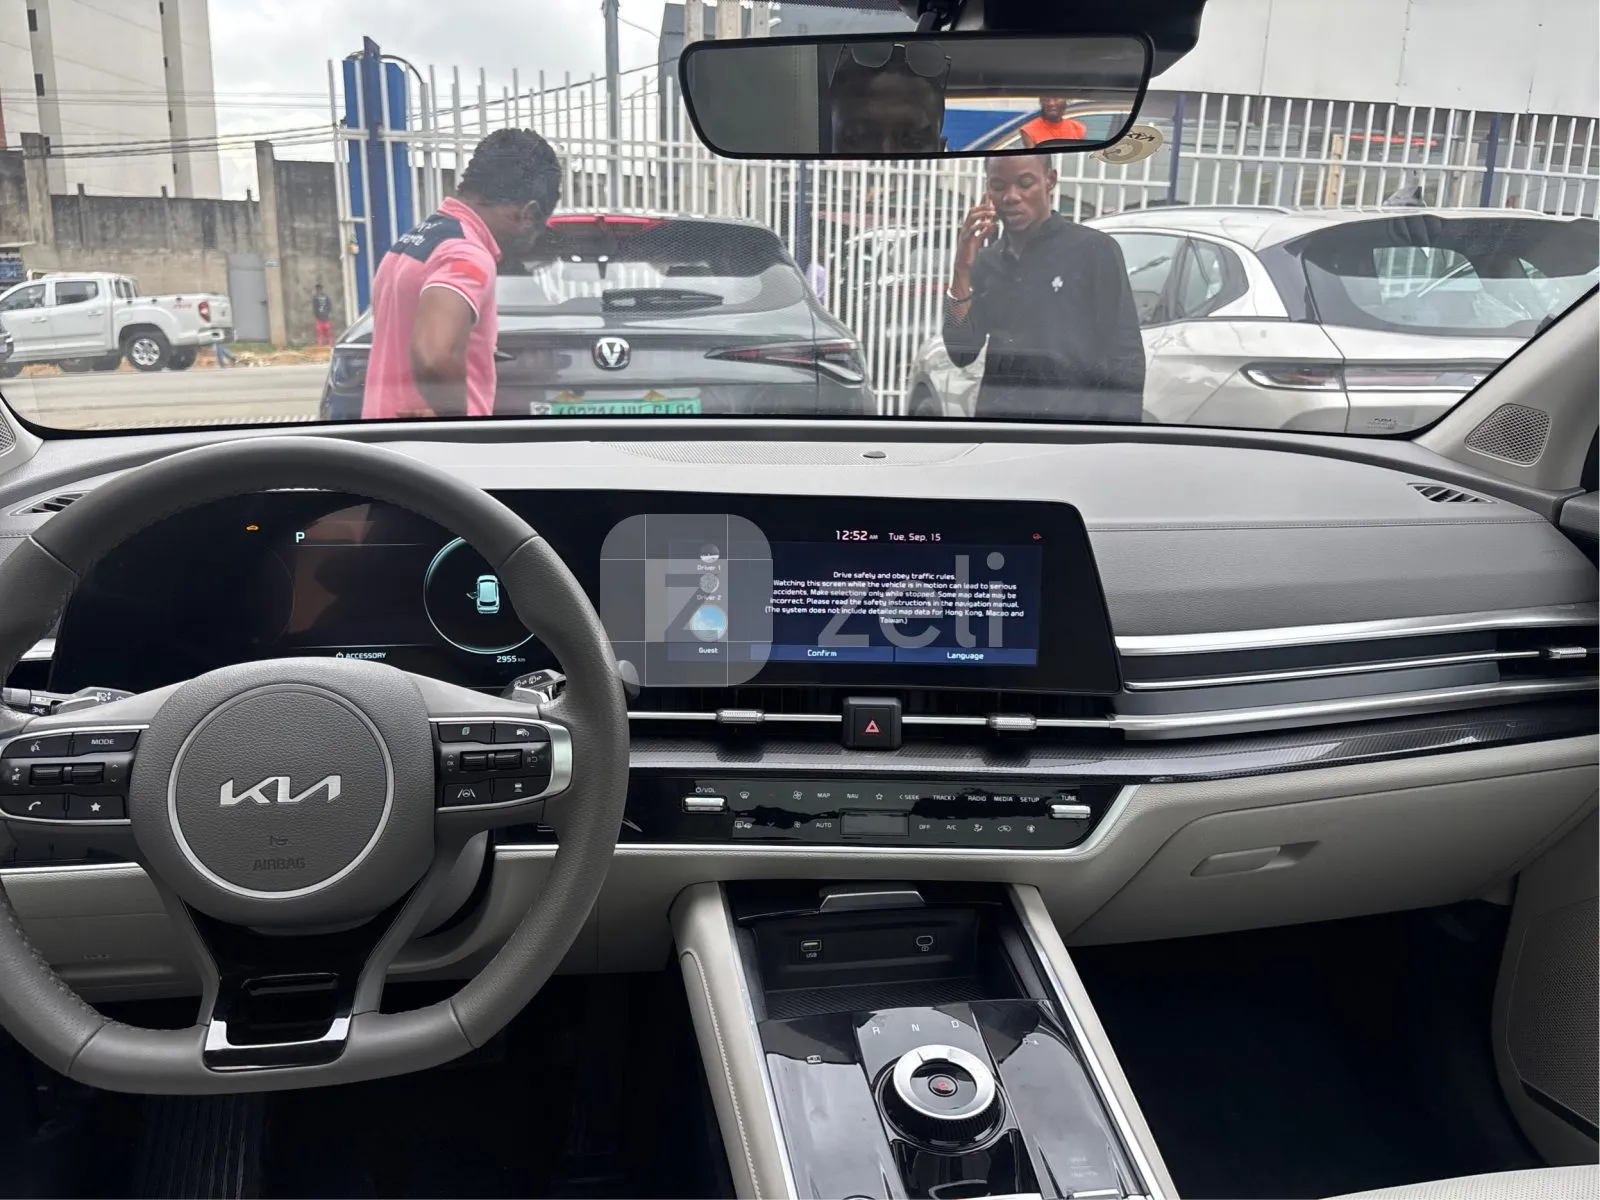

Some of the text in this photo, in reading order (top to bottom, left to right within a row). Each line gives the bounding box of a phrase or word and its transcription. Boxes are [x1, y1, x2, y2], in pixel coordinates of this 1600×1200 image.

[295, 531, 305, 543] P
[835, 530, 868, 541] 12:52
[931, 533, 941, 542] 15
[833, 571, 852, 579] Drive
[853, 571, 876, 580] safely
[892, 572, 910, 580] obey
[773, 580, 805, 588] Watching
[881, 581, 906, 589] vehicle
[773, 588, 809, 596] accidents.
[830, 589, 867, 597] selections
[868, 590, 885, 598] only
[905, 590, 937, 598] stopped.
[958, 592, 973, 600] map
[863, 598, 887, 607] safety
[888, 599, 932, 607] instructions
[932, 599, 940, 607] in
[954, 600, 992, 609] navigation
[765, 605, 781, 614] (The
[781, 607, 808, 615] system
[827, 607, 841, 615] not
[841, 607, 867, 615] include
[868, 607, 897, 615] detailed
[898, 609, 913, 617] map
[914, 608, 931, 616] data
[931, 608, 944, 616] for
[944, 608, 963, 617] Hong
[964, 609, 984, 617] Kong,
[985, 609, 1010, 617] Macao
[880, 616, 908, 625] Taiwan.)
[699, 646, 719, 654] Guest
[807, 649, 838, 657] Confirm
[345, 651, 387, 659] ACCESSORY
[496, 655, 518, 663] 2955
[946, 651, 985, 660] Language
[220, 774, 342, 806] KIA
[252, 857, 306, 872] AIRBAG
[911, 1023, 920, 1032] N
[951, 1020, 960, 1029] D
[871, 1026, 881, 1035] R
